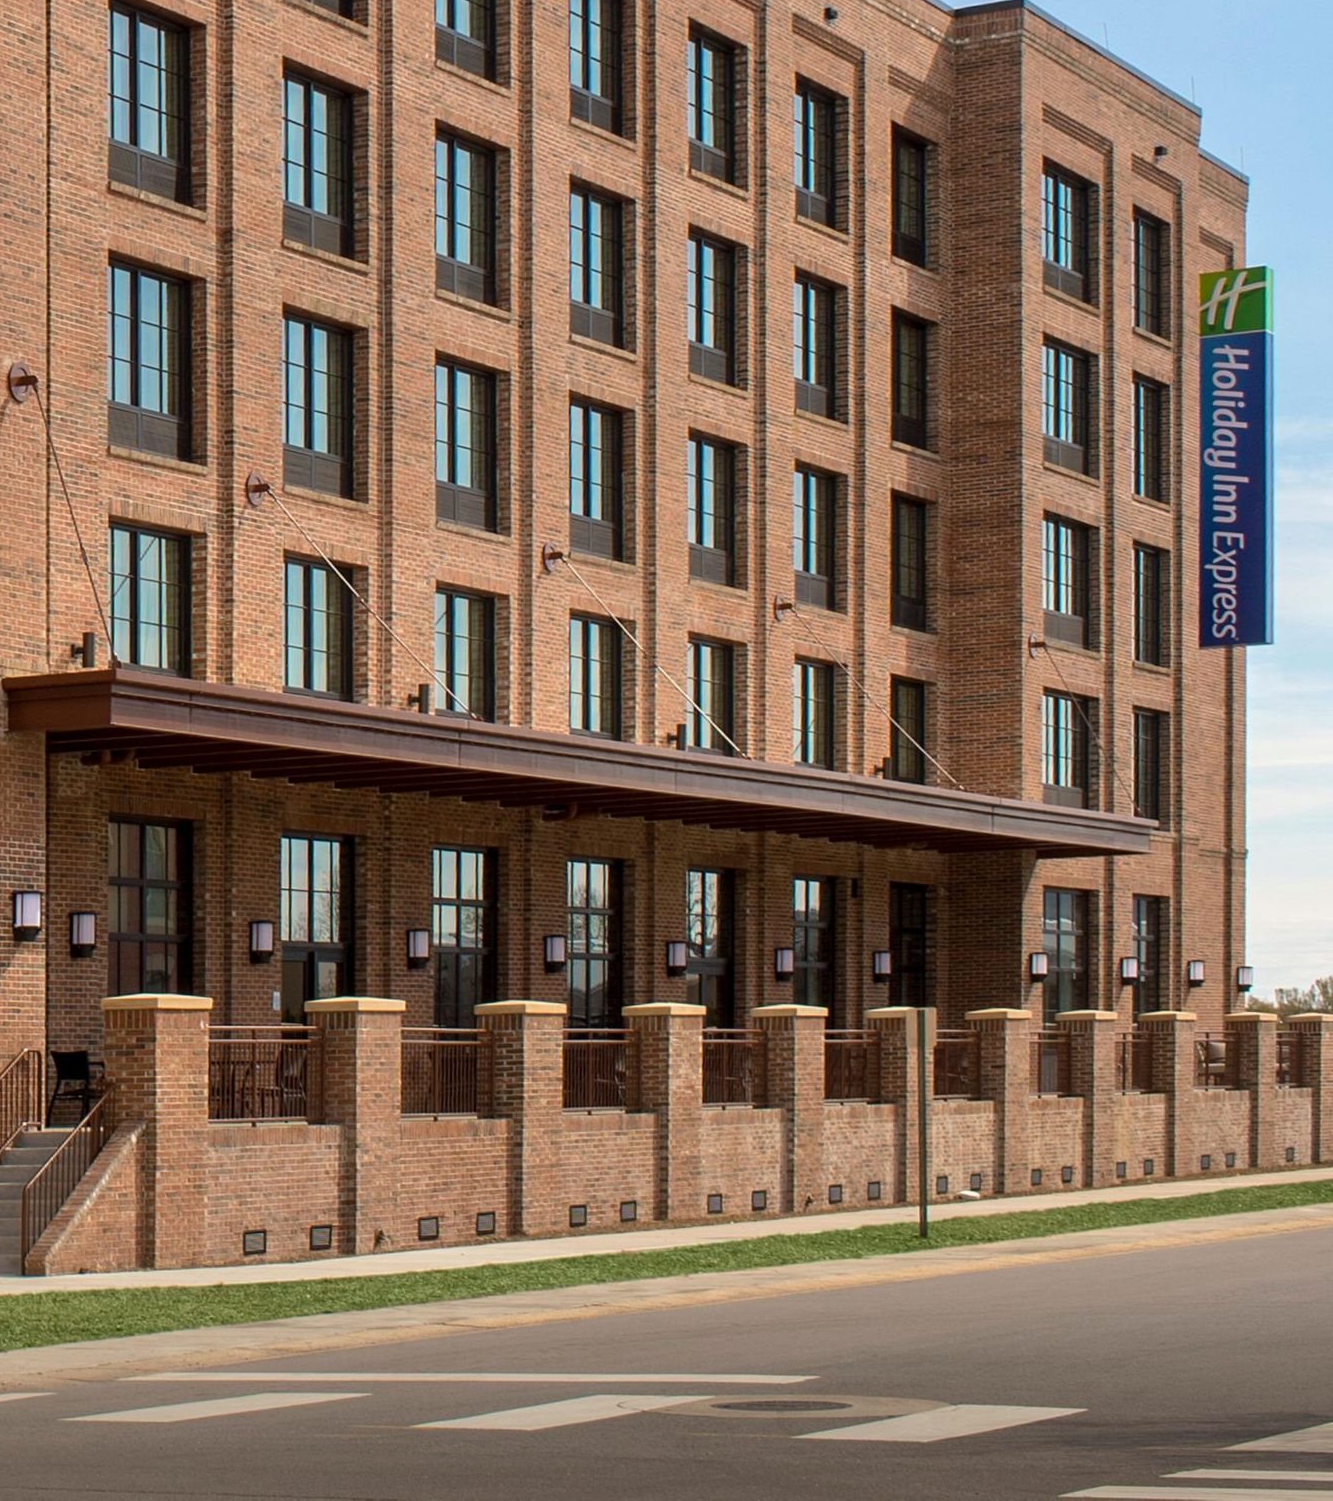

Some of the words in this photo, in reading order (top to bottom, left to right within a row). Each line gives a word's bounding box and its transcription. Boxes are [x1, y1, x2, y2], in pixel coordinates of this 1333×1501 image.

[1204, 344, 1249, 469] Holiday
[1213, 474, 1249, 523] Inn
[1204, 531, 1244, 639] Express
